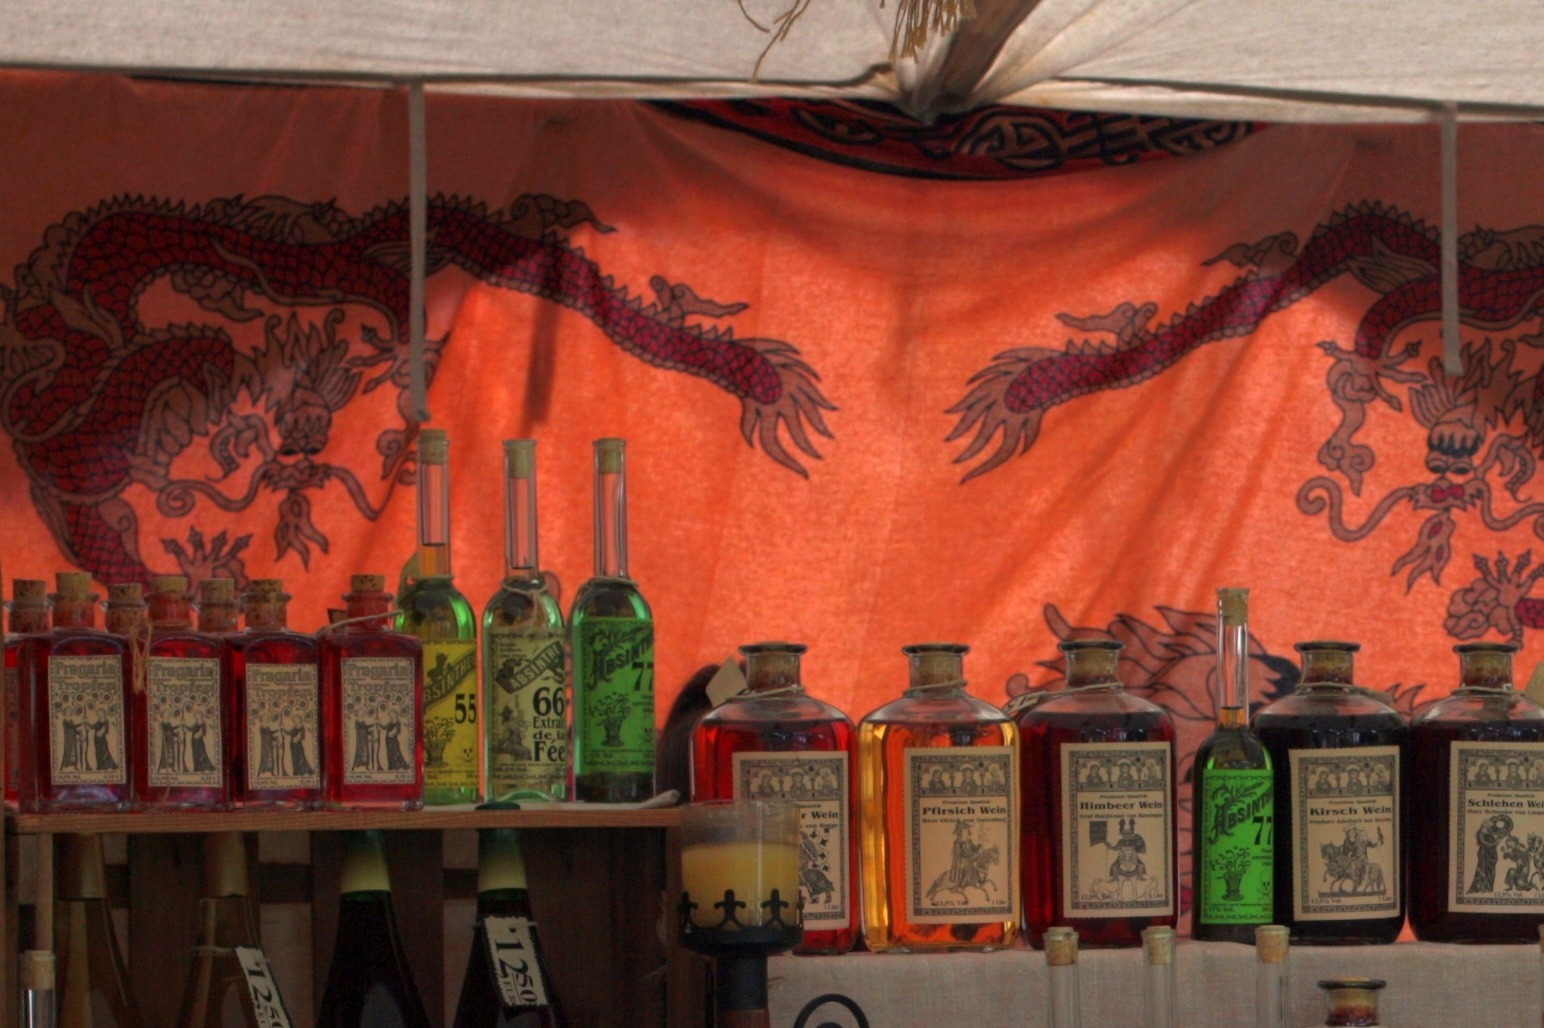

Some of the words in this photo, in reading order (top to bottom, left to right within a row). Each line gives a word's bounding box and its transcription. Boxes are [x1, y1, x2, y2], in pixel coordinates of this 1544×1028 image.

[423, 655, 477, 702] BSINTHE
[533, 687, 565, 717] 66
[455, 693, 477, 724] 55
[533, 739, 565, 762] Fée
[1080, 802, 1135, 810] Himbeer
[1139, 801, 1163, 809] Wein
[1467, 799, 1523, 808] Schlehen
[811, 810, 839, 819] Wein
[922, 806, 975, 815] Pfirsich
[980, 806, 1006, 814] Wein
[1310, 807, 1357, 816] Kirsch
[1362, 806, 1391, 814] Wein
